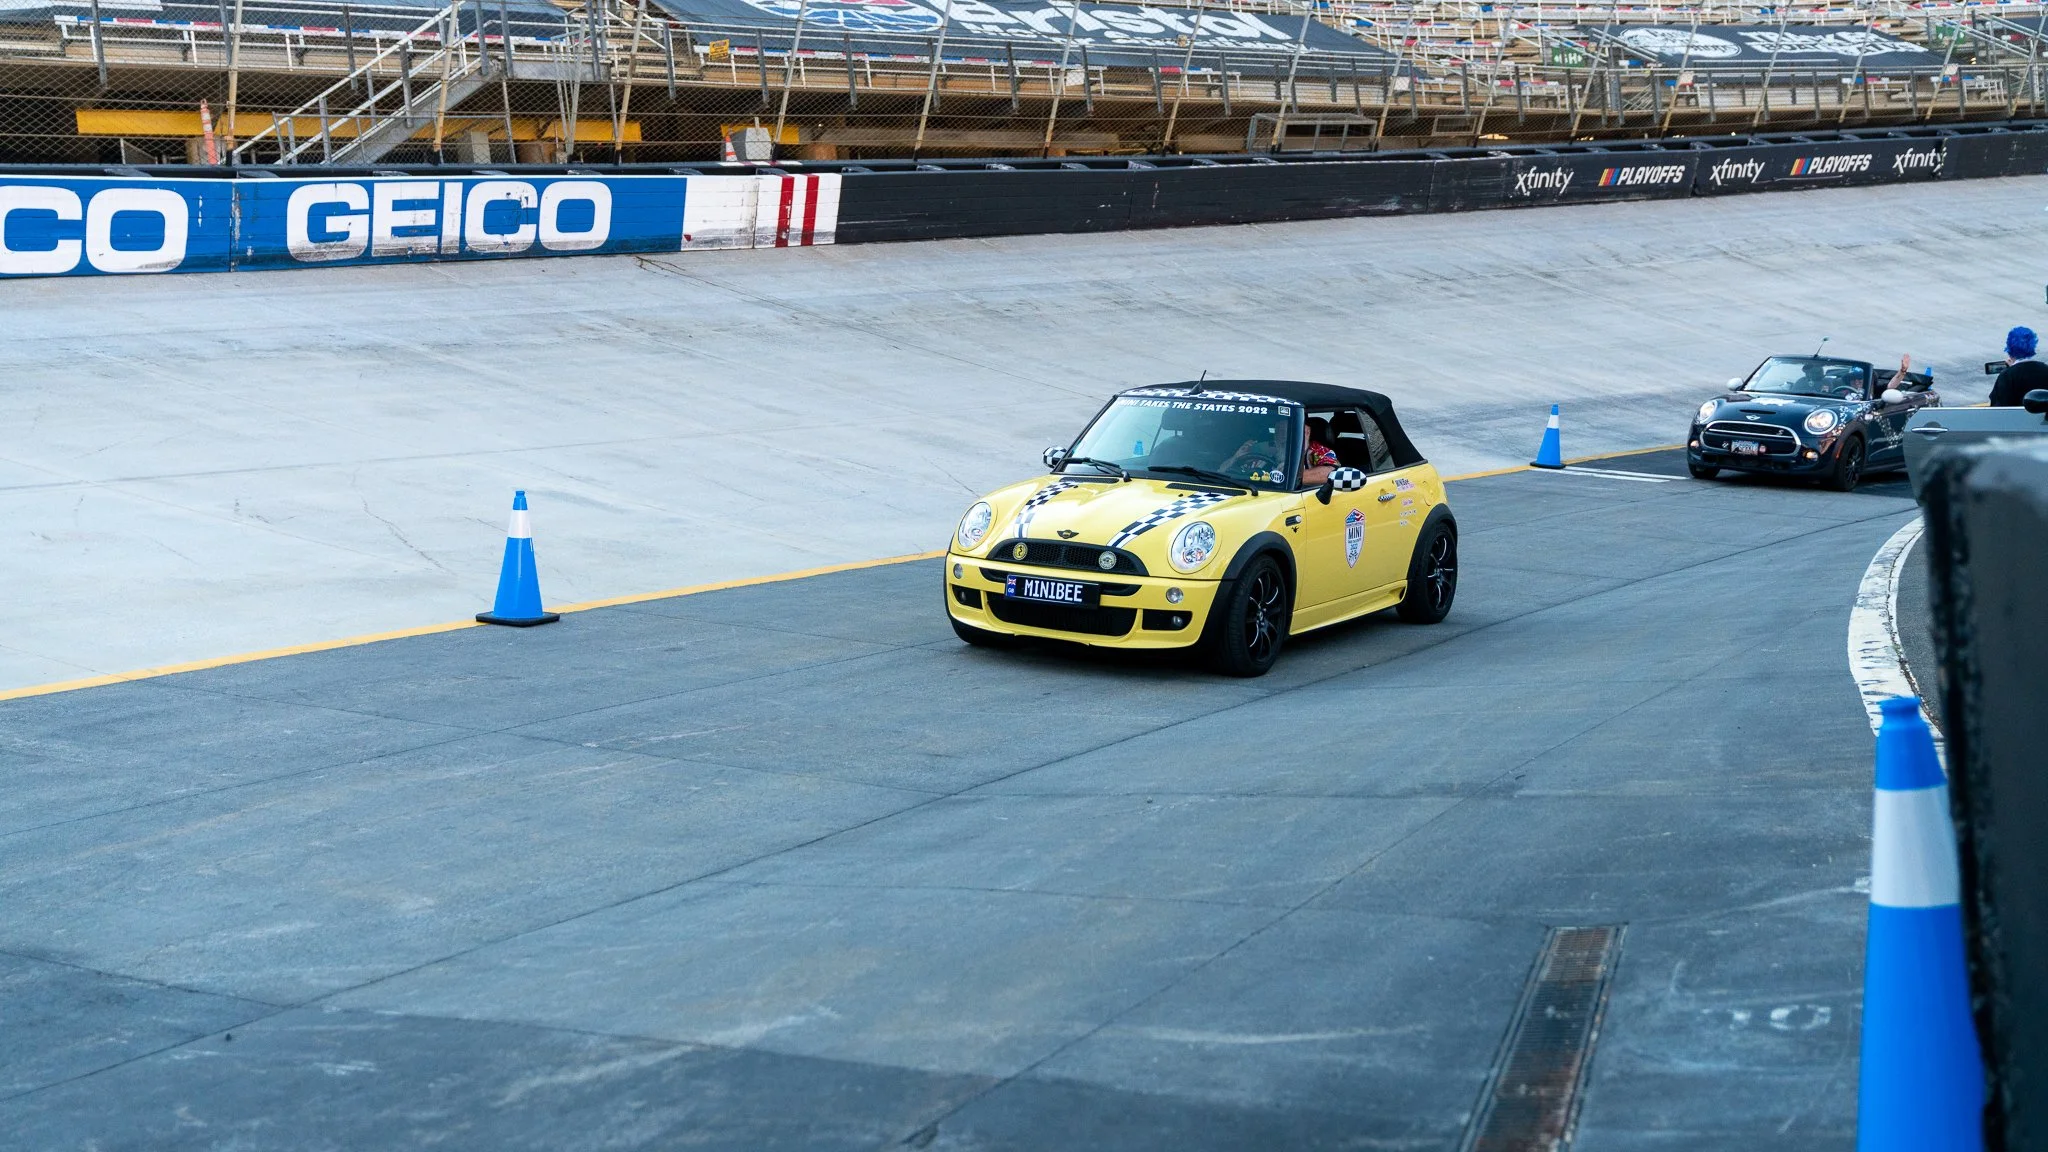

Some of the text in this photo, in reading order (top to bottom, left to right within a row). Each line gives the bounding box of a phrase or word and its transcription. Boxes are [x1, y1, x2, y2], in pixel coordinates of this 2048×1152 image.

[925, 0, 1293, 40] Bristol
[1515, 165, 1685, 196] xfinity PLAYOFFS
[1709, 147, 1947, 186] xfinity PLAYOFFS xfinity
[286, 181, 613, 262] GEICO
[1140, 400, 1171, 408] TAKES
[1172, 401, 1193, 410] THE
[1194, 403, 1236, 412] STATES
[1238, 405, 1268, 415] 2022
[1348, 526, 1362, 540] MINI
[1024, 579, 1083, 602] MINIBEE
